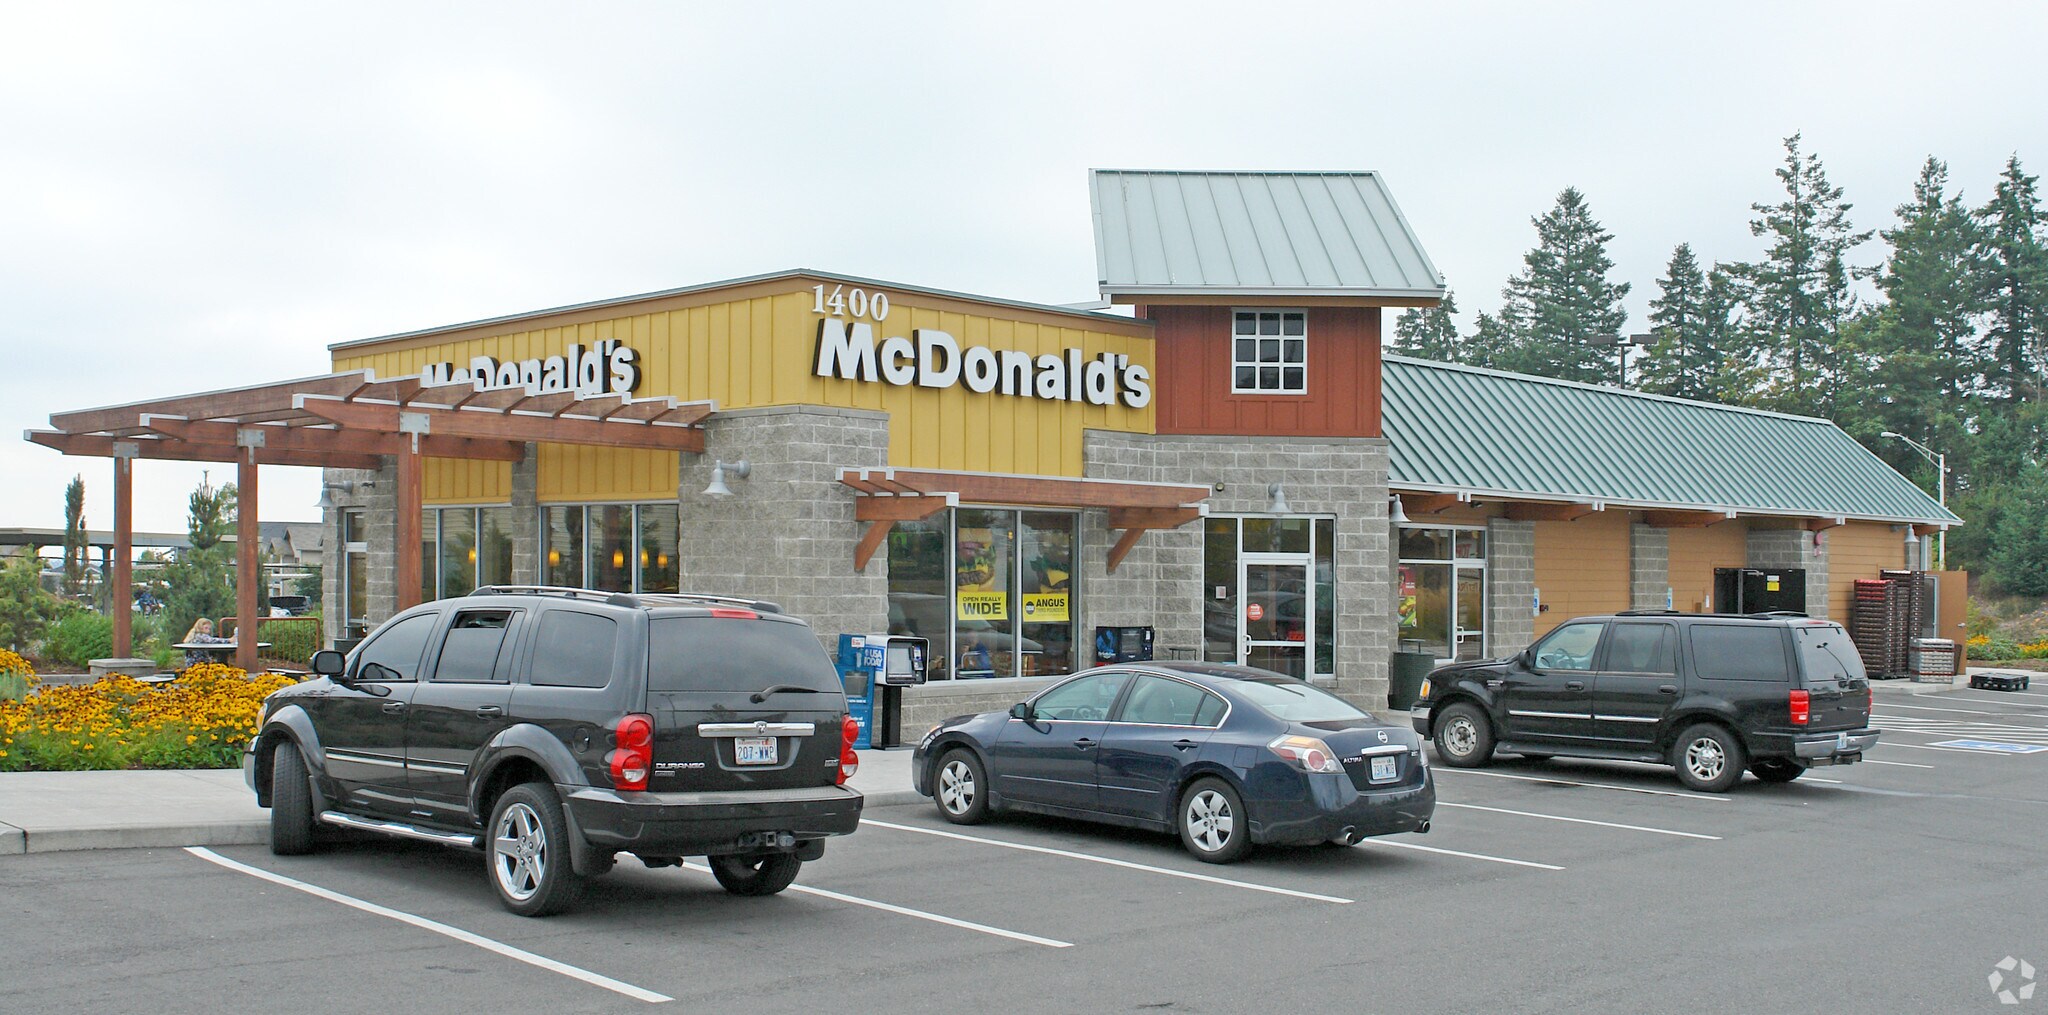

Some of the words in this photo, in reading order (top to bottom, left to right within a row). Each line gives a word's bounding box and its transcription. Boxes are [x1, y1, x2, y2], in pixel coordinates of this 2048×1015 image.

[811, 284, 889, 322] 1400
[813, 317, 1151, 409] McDonald's
[963, 602, 1002, 615] WIDE
[1036, 598, 1065, 608] ANGUS
[870, 649, 882, 658] USA
[863, 656, 883, 667] TODAY
